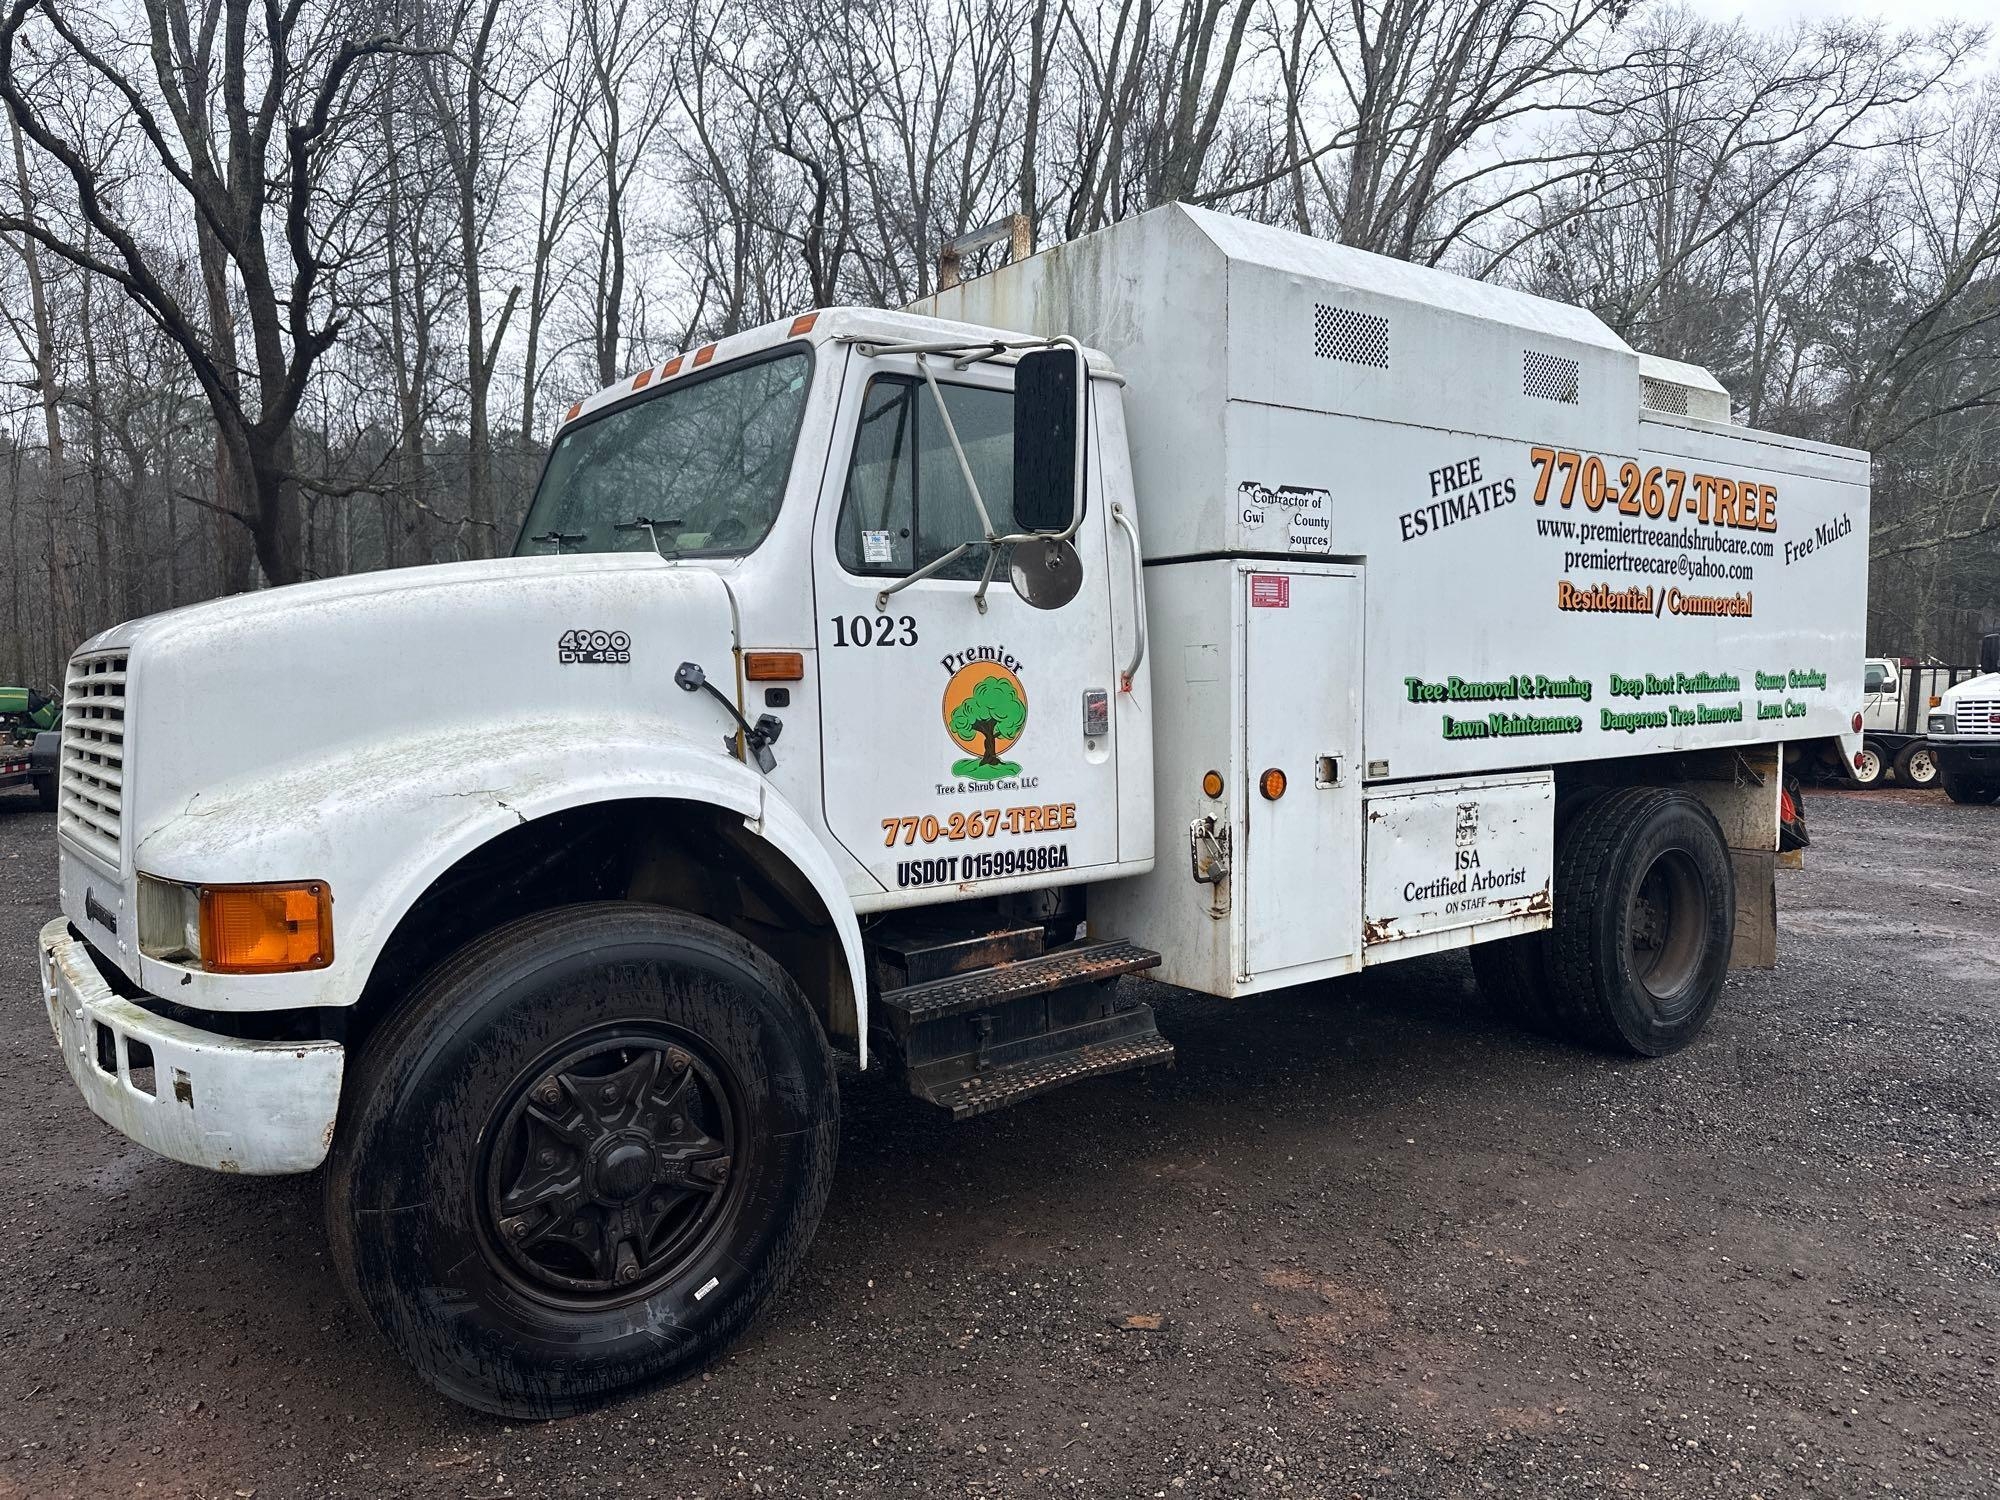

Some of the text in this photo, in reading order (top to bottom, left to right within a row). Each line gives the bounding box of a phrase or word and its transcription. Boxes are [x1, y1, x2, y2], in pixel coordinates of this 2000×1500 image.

[1429, 457, 1483, 497] FREE
[1530, 447, 1778, 533] 770-267-TREE
[1253, 490, 1322, 508] Contractor of
[1399, 478, 1516, 542] ESTIMATES
[1294, 513, 1329, 530] County
[1290, 535, 1328, 545] sources
[1536, 518, 1774, 557] www.premiertreeandshrubcare.com
[1783, 513, 1852, 566] Free Mulch
[1564, 548, 1753, 581] premiertreecare@yahoo.com
[1558, 581, 1652, 614] Residential
[1667, 590, 1753, 617] Commercial
[559, 630, 631, 650] 4900
[831, 615, 918, 647] 1023
[560, 651, 630, 662] DT 466
[940, 645, 1023, 676] Premier
[1404, 675, 1592, 702] Tree Removal & Pruning
[1609, 672, 1740, 699] Deep Root Fertilization
[1755, 668, 1827, 691] Stump Grinding
[1600, 701, 1743, 733] Dangerous Tree Removal
[1757, 698, 1807, 720] Lawn Care
[1442, 712, 1582, 739] Lawn Maintenance
[936, 776, 1038, 795] Tree & Shrub Care, LLC
[882, 803, 1077, 848] 770-267-TREE
[897, 846, 1068, 887] USDOT 01599498GA
[1455, 850, 1480, 871] ISA
[1404, 867, 1526, 901] Certified Arborist
[1445, 897, 1487, 914] ON STAFF
